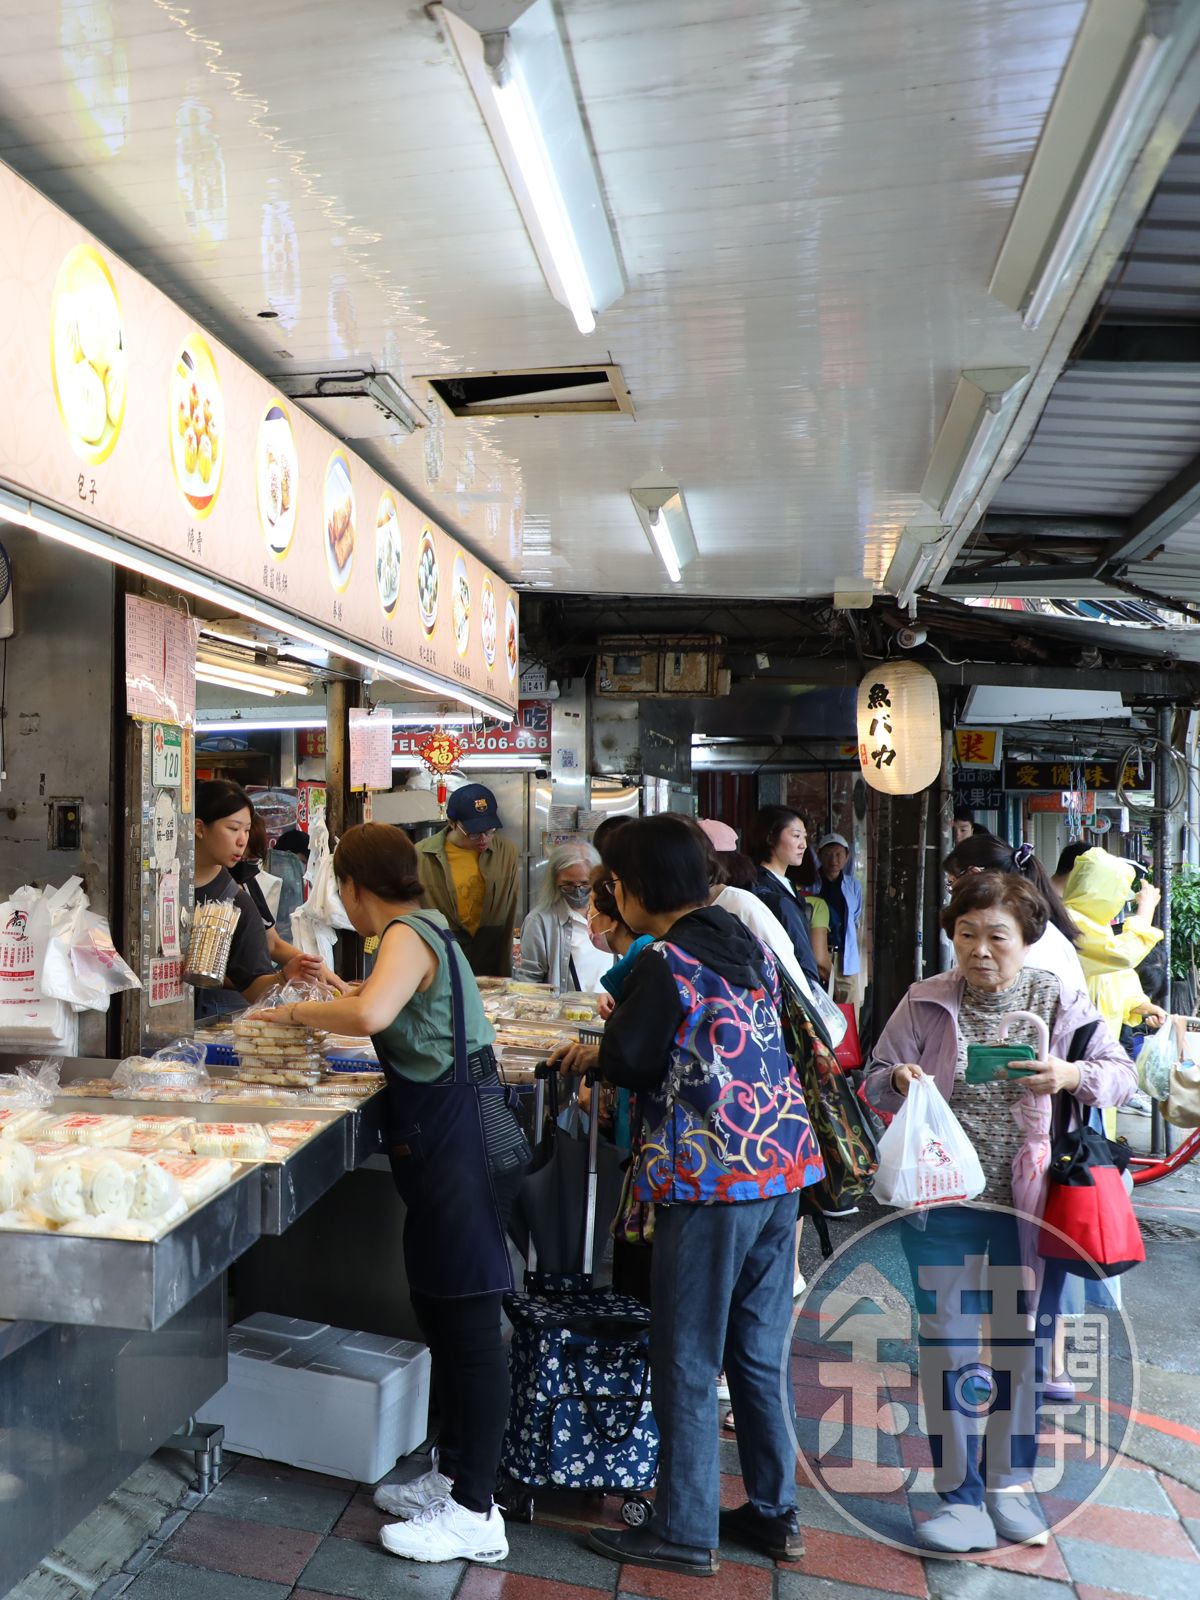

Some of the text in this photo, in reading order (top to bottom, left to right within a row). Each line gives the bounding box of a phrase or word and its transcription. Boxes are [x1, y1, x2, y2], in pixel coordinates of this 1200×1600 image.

[77, 472, 98, 504] 包子
[429, 740, 454, 764] 福
[455, 737, 549, 751] 6-306-668
[959, 732, 989, 762] 裝
[164, 752, 179, 778] 120
[954, 788, 1003, 808] 水果行
